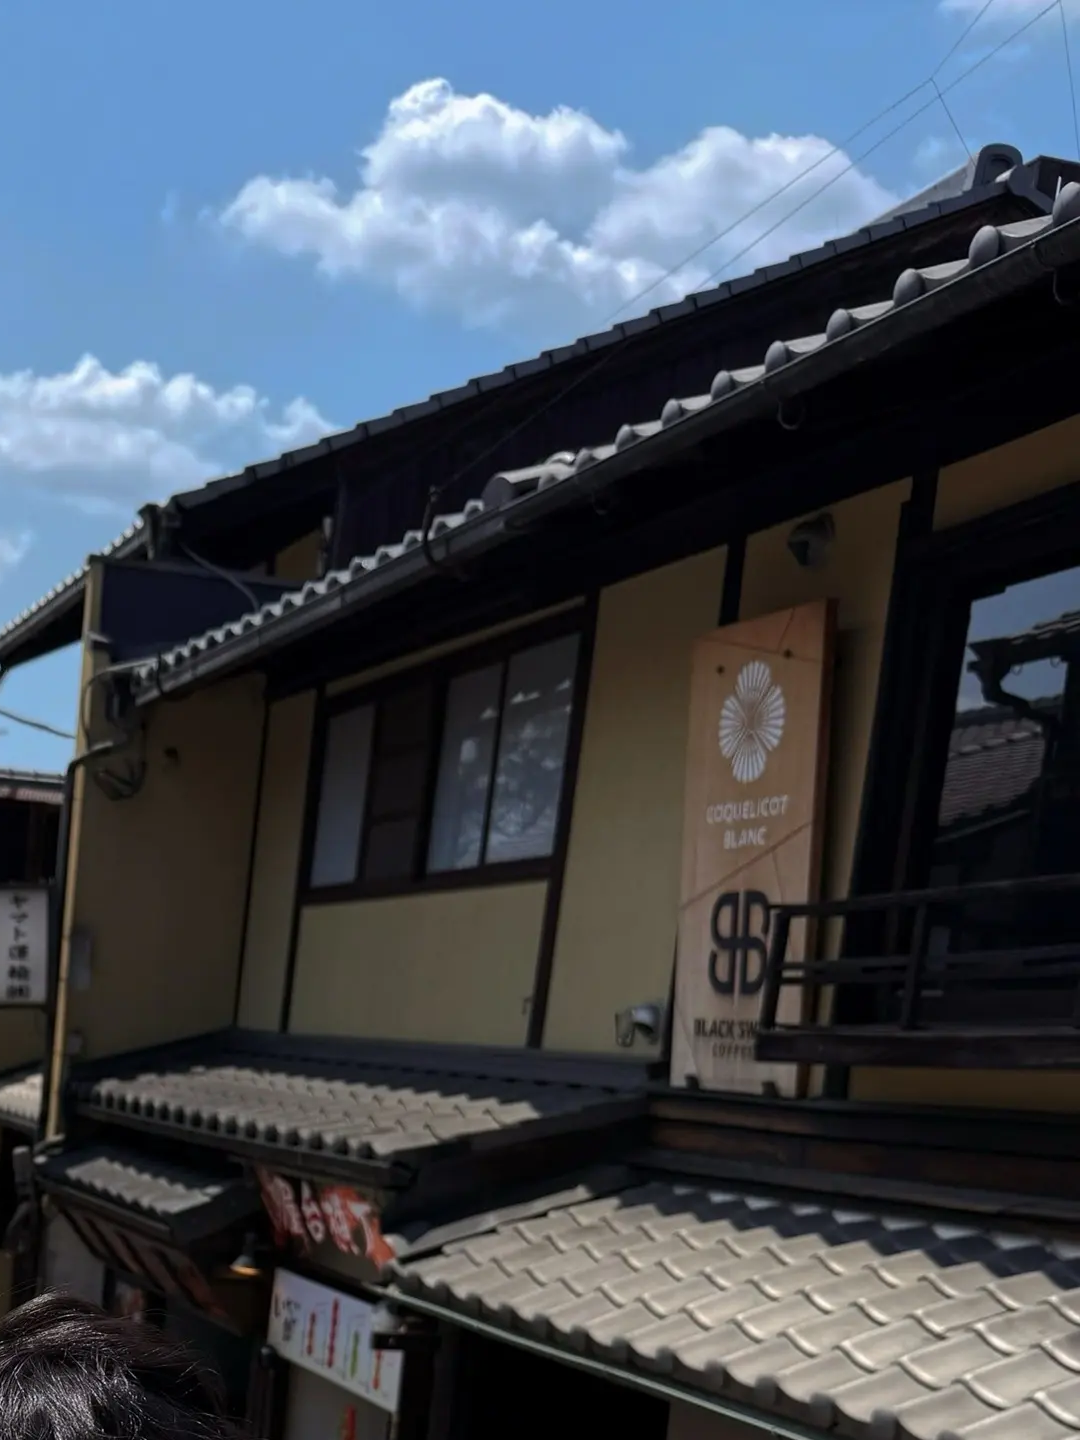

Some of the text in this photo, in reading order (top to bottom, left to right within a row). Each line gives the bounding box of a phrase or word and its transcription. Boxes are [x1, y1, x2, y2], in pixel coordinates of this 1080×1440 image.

[706, 794, 789, 824] COQUELICOT
[723, 826, 767, 849] BLANC
[695, 1020, 734, 1037] BLACK
